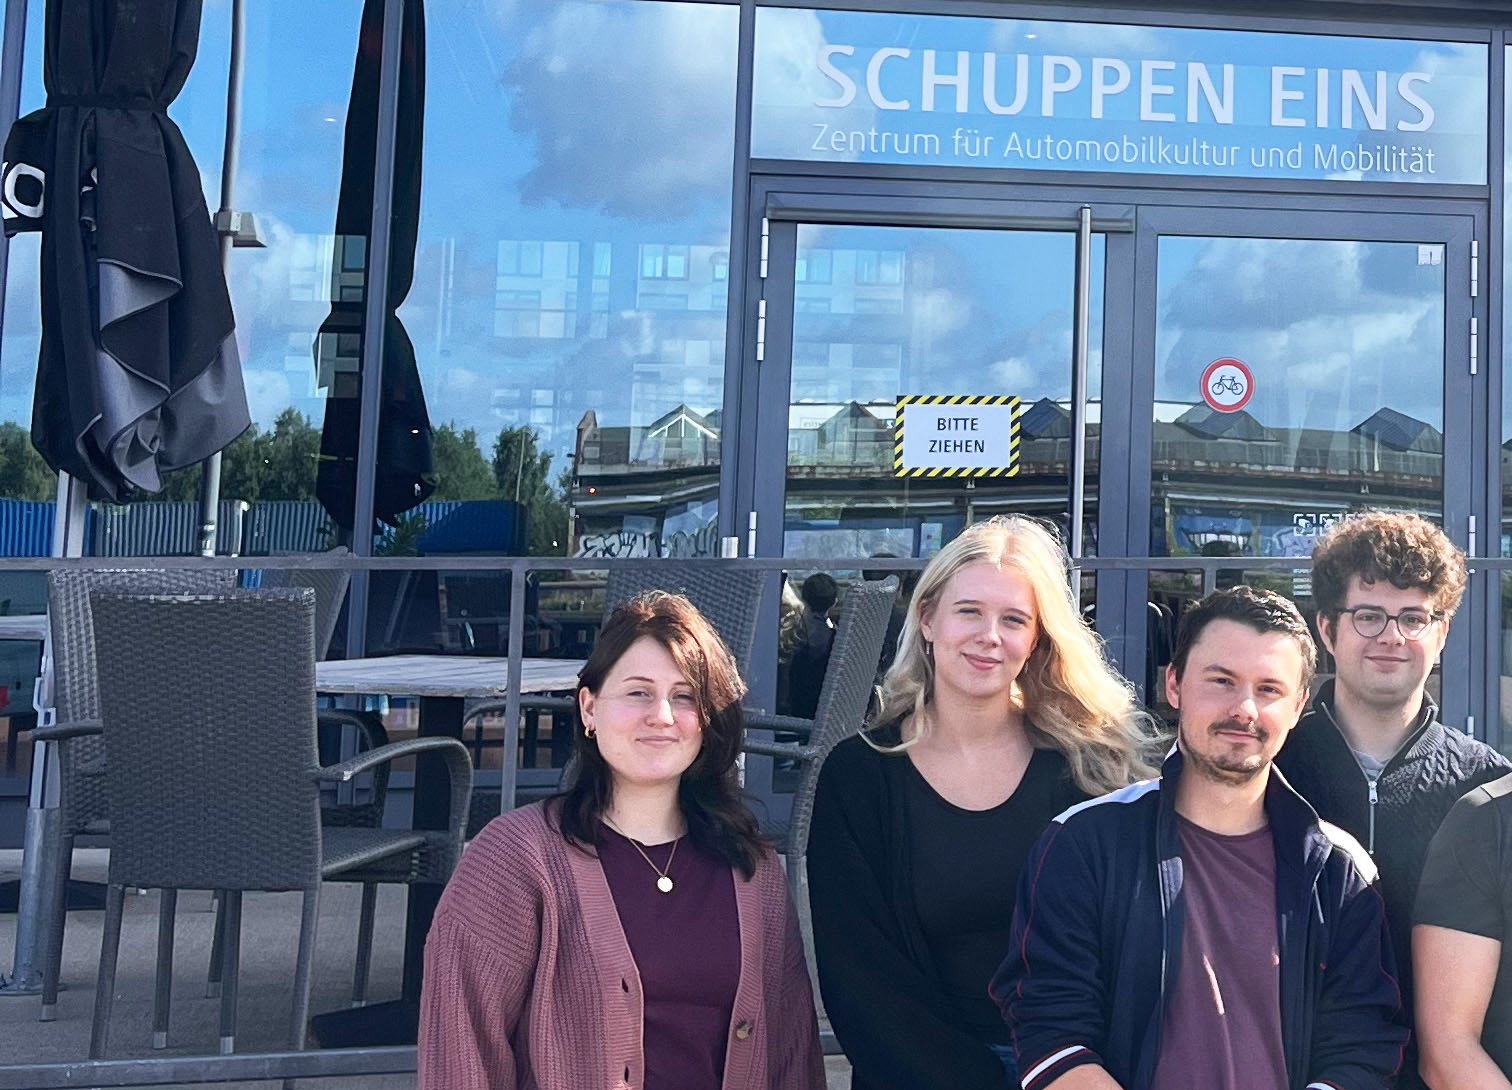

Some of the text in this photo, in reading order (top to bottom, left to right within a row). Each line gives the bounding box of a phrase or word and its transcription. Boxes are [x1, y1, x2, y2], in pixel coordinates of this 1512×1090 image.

[815, 44, 1436, 132] SCHUPPEN EINS
[811, 123, 1437, 174] Zentrum für Automobilkultur und Mobilität
[937, 417, 979, 431] BITTE
[928, 439, 985, 453] ZIEHEN
